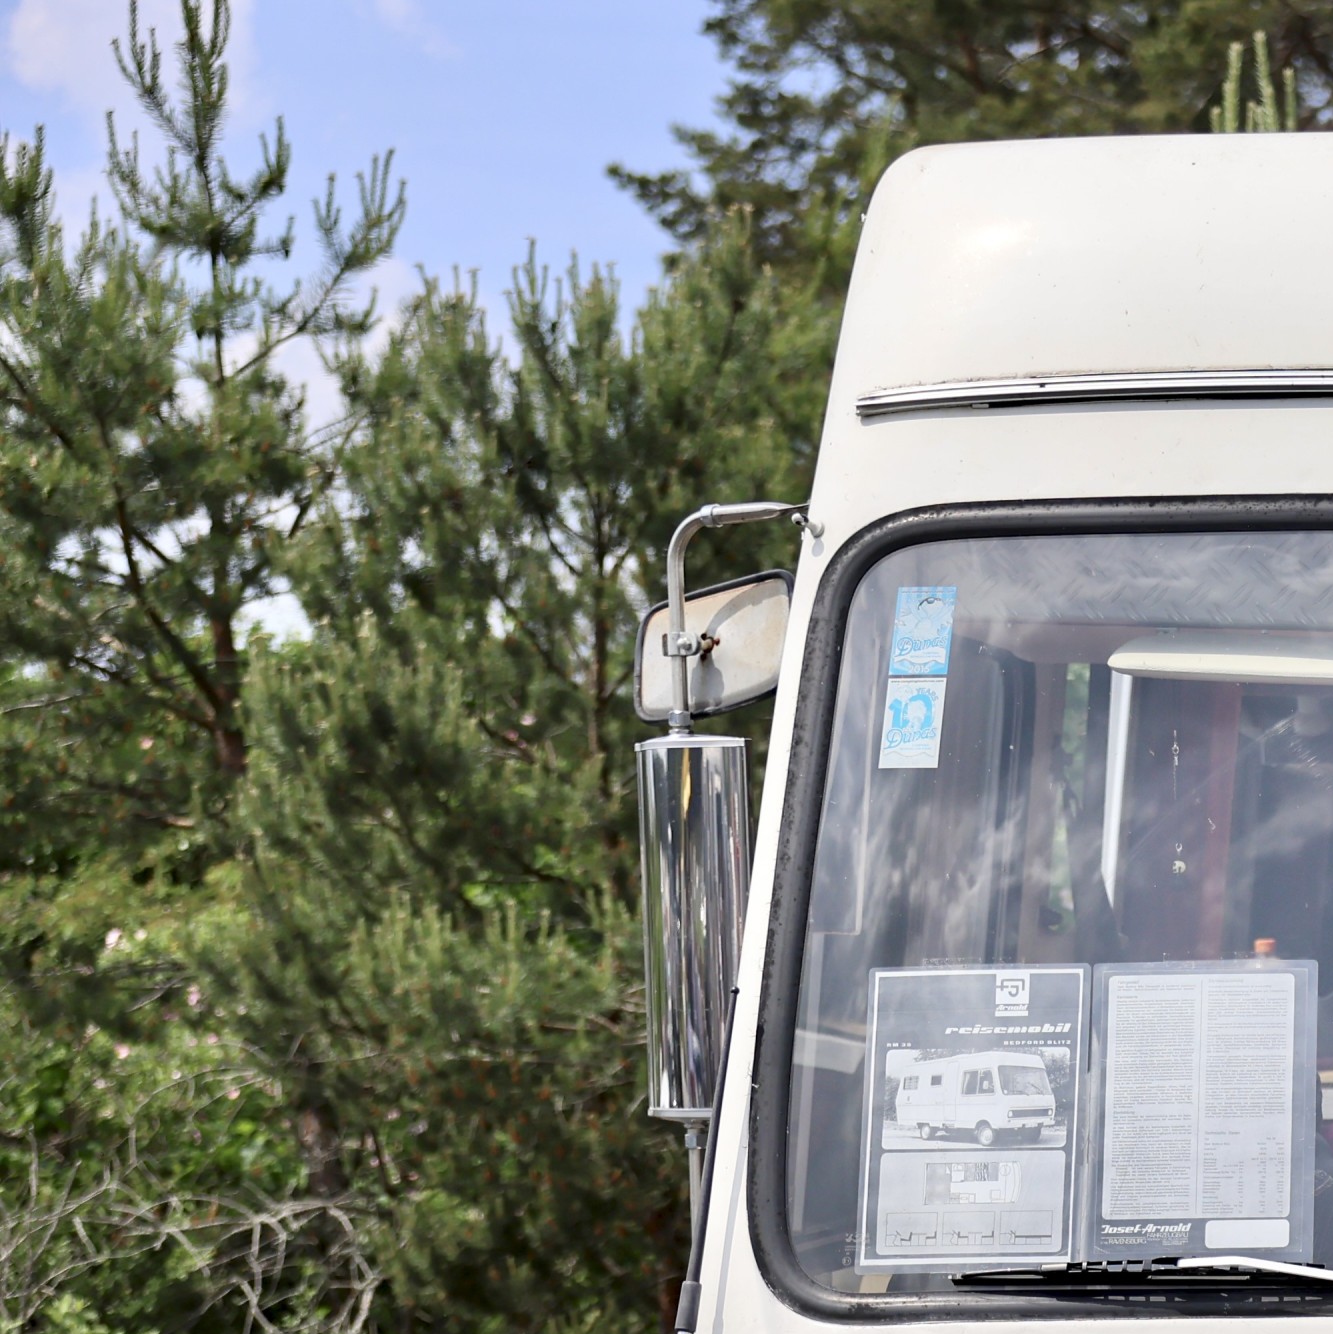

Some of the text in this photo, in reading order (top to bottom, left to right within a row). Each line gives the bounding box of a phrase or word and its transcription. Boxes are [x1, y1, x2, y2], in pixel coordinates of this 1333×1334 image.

[894, 636, 947, 657] Dunas
[916, 687, 939, 702] YEARS
[883, 728, 938, 750] Dunas
[944, 1023, 1072, 1035] reisemobil
